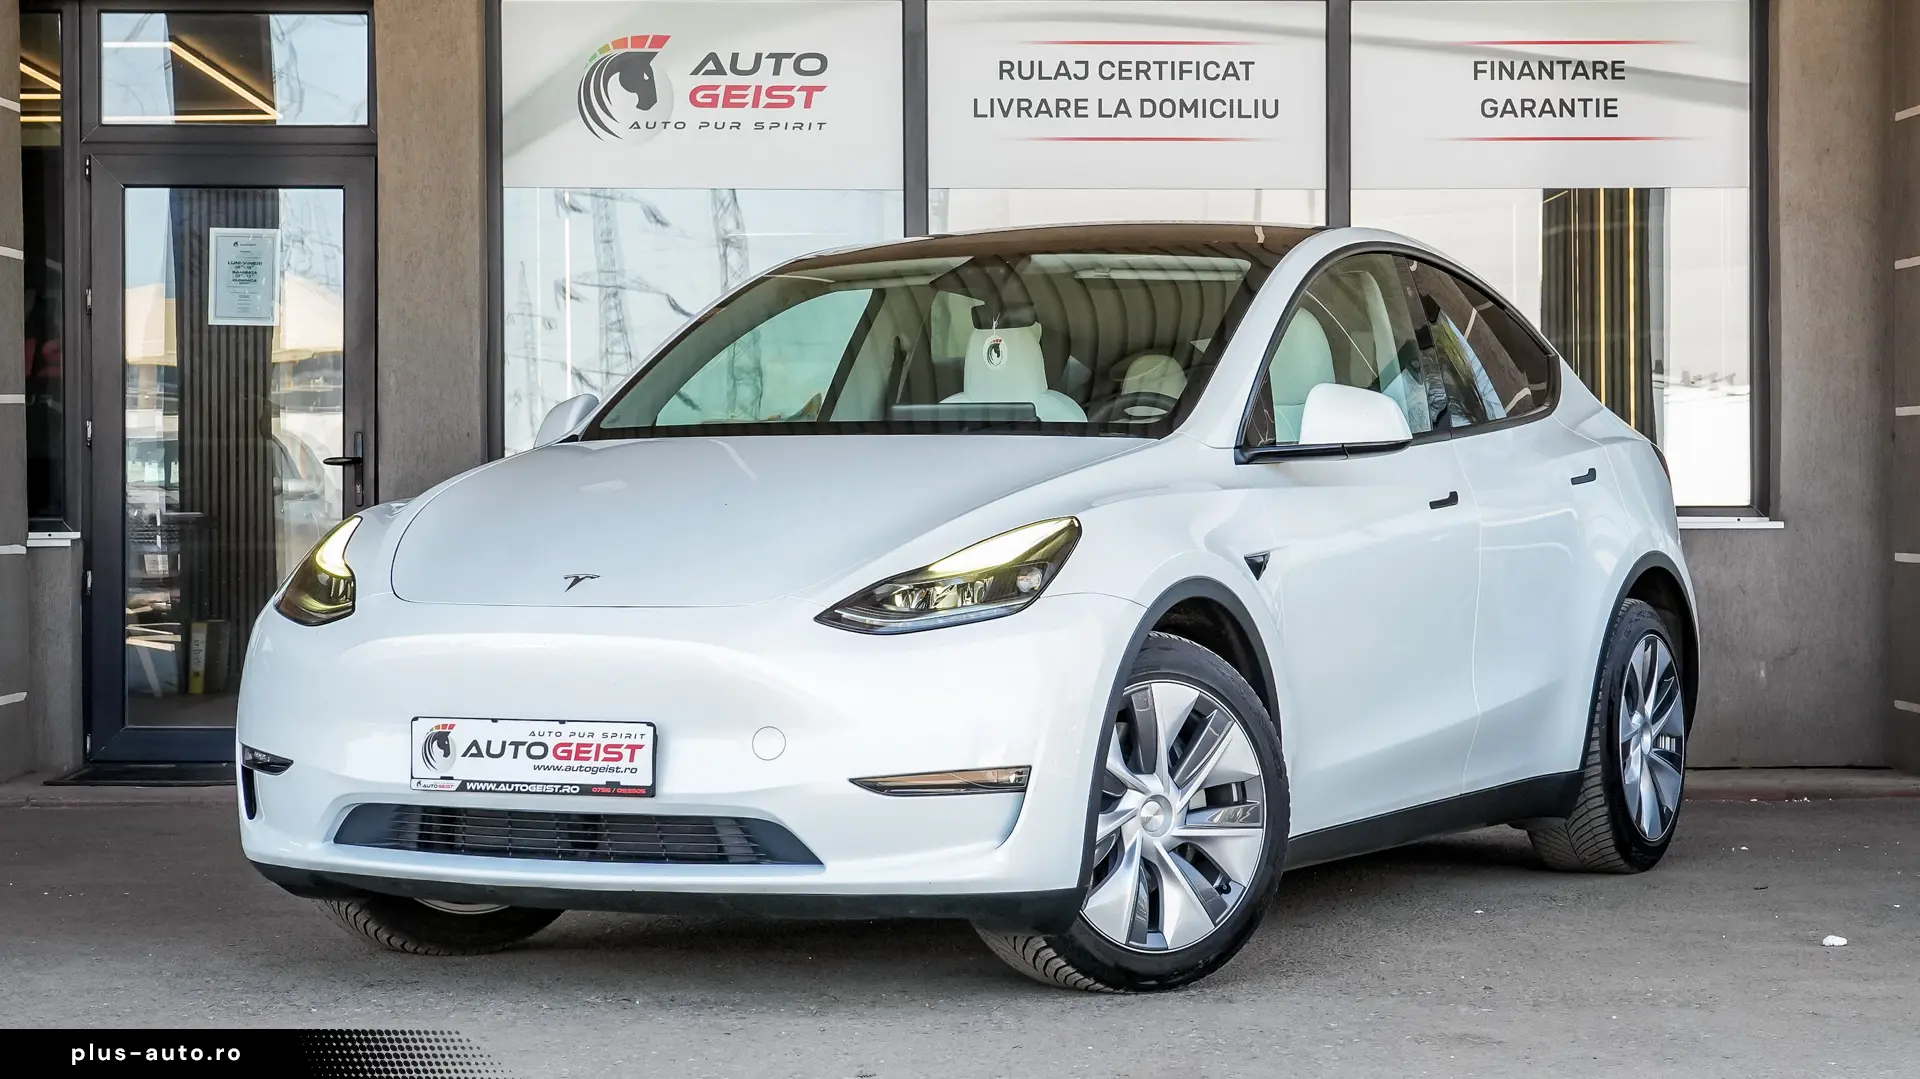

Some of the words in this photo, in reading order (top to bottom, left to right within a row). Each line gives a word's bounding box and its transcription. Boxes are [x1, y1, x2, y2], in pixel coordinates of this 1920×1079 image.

[689, 52, 828, 76] AUTO
[998, 60, 1089, 81] RULAJ
[1097, 60, 1256, 82] CERTIFICAT
[1473, 60, 1626, 81] FINANTARE
[689, 85, 827, 108] GEIST
[973, 98, 1089, 118] LIVRARE
[1097, 98, 1132, 119] LA
[1140, 98, 1279, 119] DOMICILIU
[1480, 98, 1618, 118] GARANTIE
[629, 121, 686, 130] AUTO
[698, 122, 741, 130] PUR
[754, 122, 827, 131] SPIRIT
[528, 730, 563, 738] AUTO
[568, 731, 595, 739] PUR
[460, 739, 646, 763] AUTOGEIST
[533, 763, 638, 775] www.autogeist.ro
[466, 782, 581, 794] WWW.AUTOGEIST.RO
